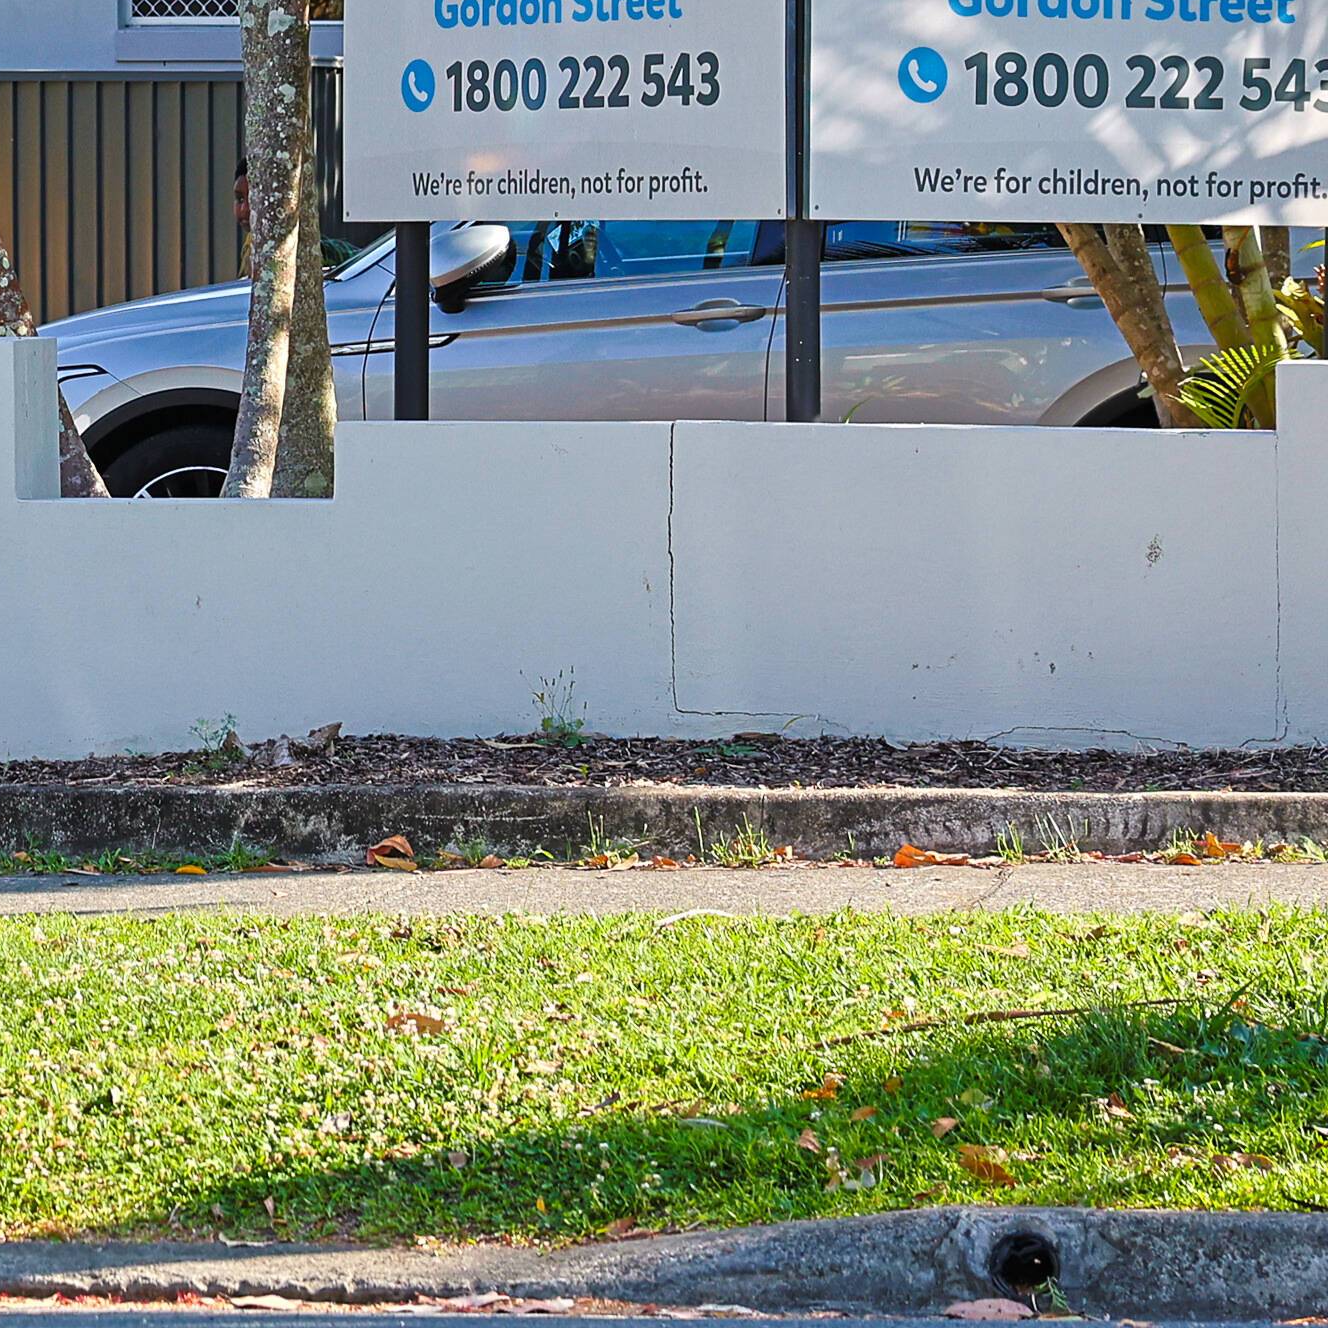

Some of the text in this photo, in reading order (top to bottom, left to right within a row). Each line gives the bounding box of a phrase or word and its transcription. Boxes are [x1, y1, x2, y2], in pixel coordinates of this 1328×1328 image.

[446, 51, 721, 113] 1800 222 543
[963, 51, 1110, 109] 1800
[1125, 54, 1224, 110] 222
[412, 167, 708, 200] We're for children, not for profit.
[914, 167, 1328, 205] We're for children, not for profit.
